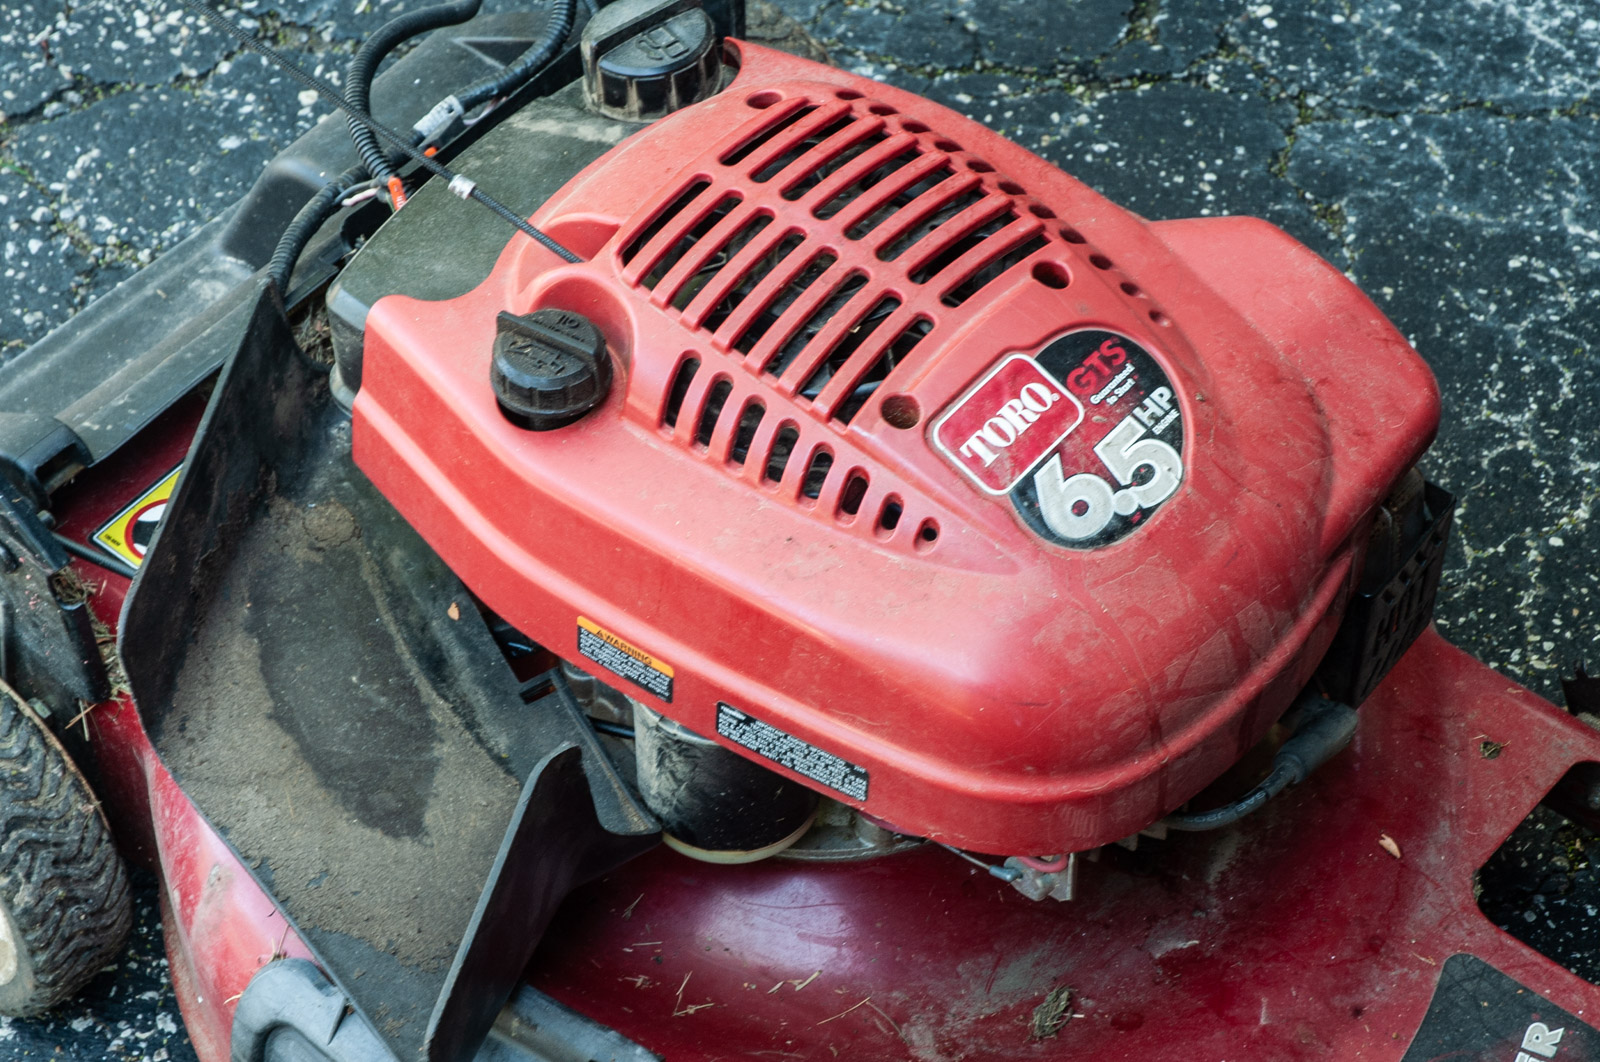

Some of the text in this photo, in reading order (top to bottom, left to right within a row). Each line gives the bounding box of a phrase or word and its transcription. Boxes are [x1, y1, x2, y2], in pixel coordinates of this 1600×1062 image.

[1066, 340, 1127, 395] GTS
[1090, 363, 1136, 405] Guaranteed
[1106, 378, 1136, 406] to Start
[1151, 408, 1180, 435] ENGINE
[1034, 386, 1183, 539] 6.5 HP
[606, 634, 652, 665] WARNING
[1235, 790, 1266, 812] SAE
